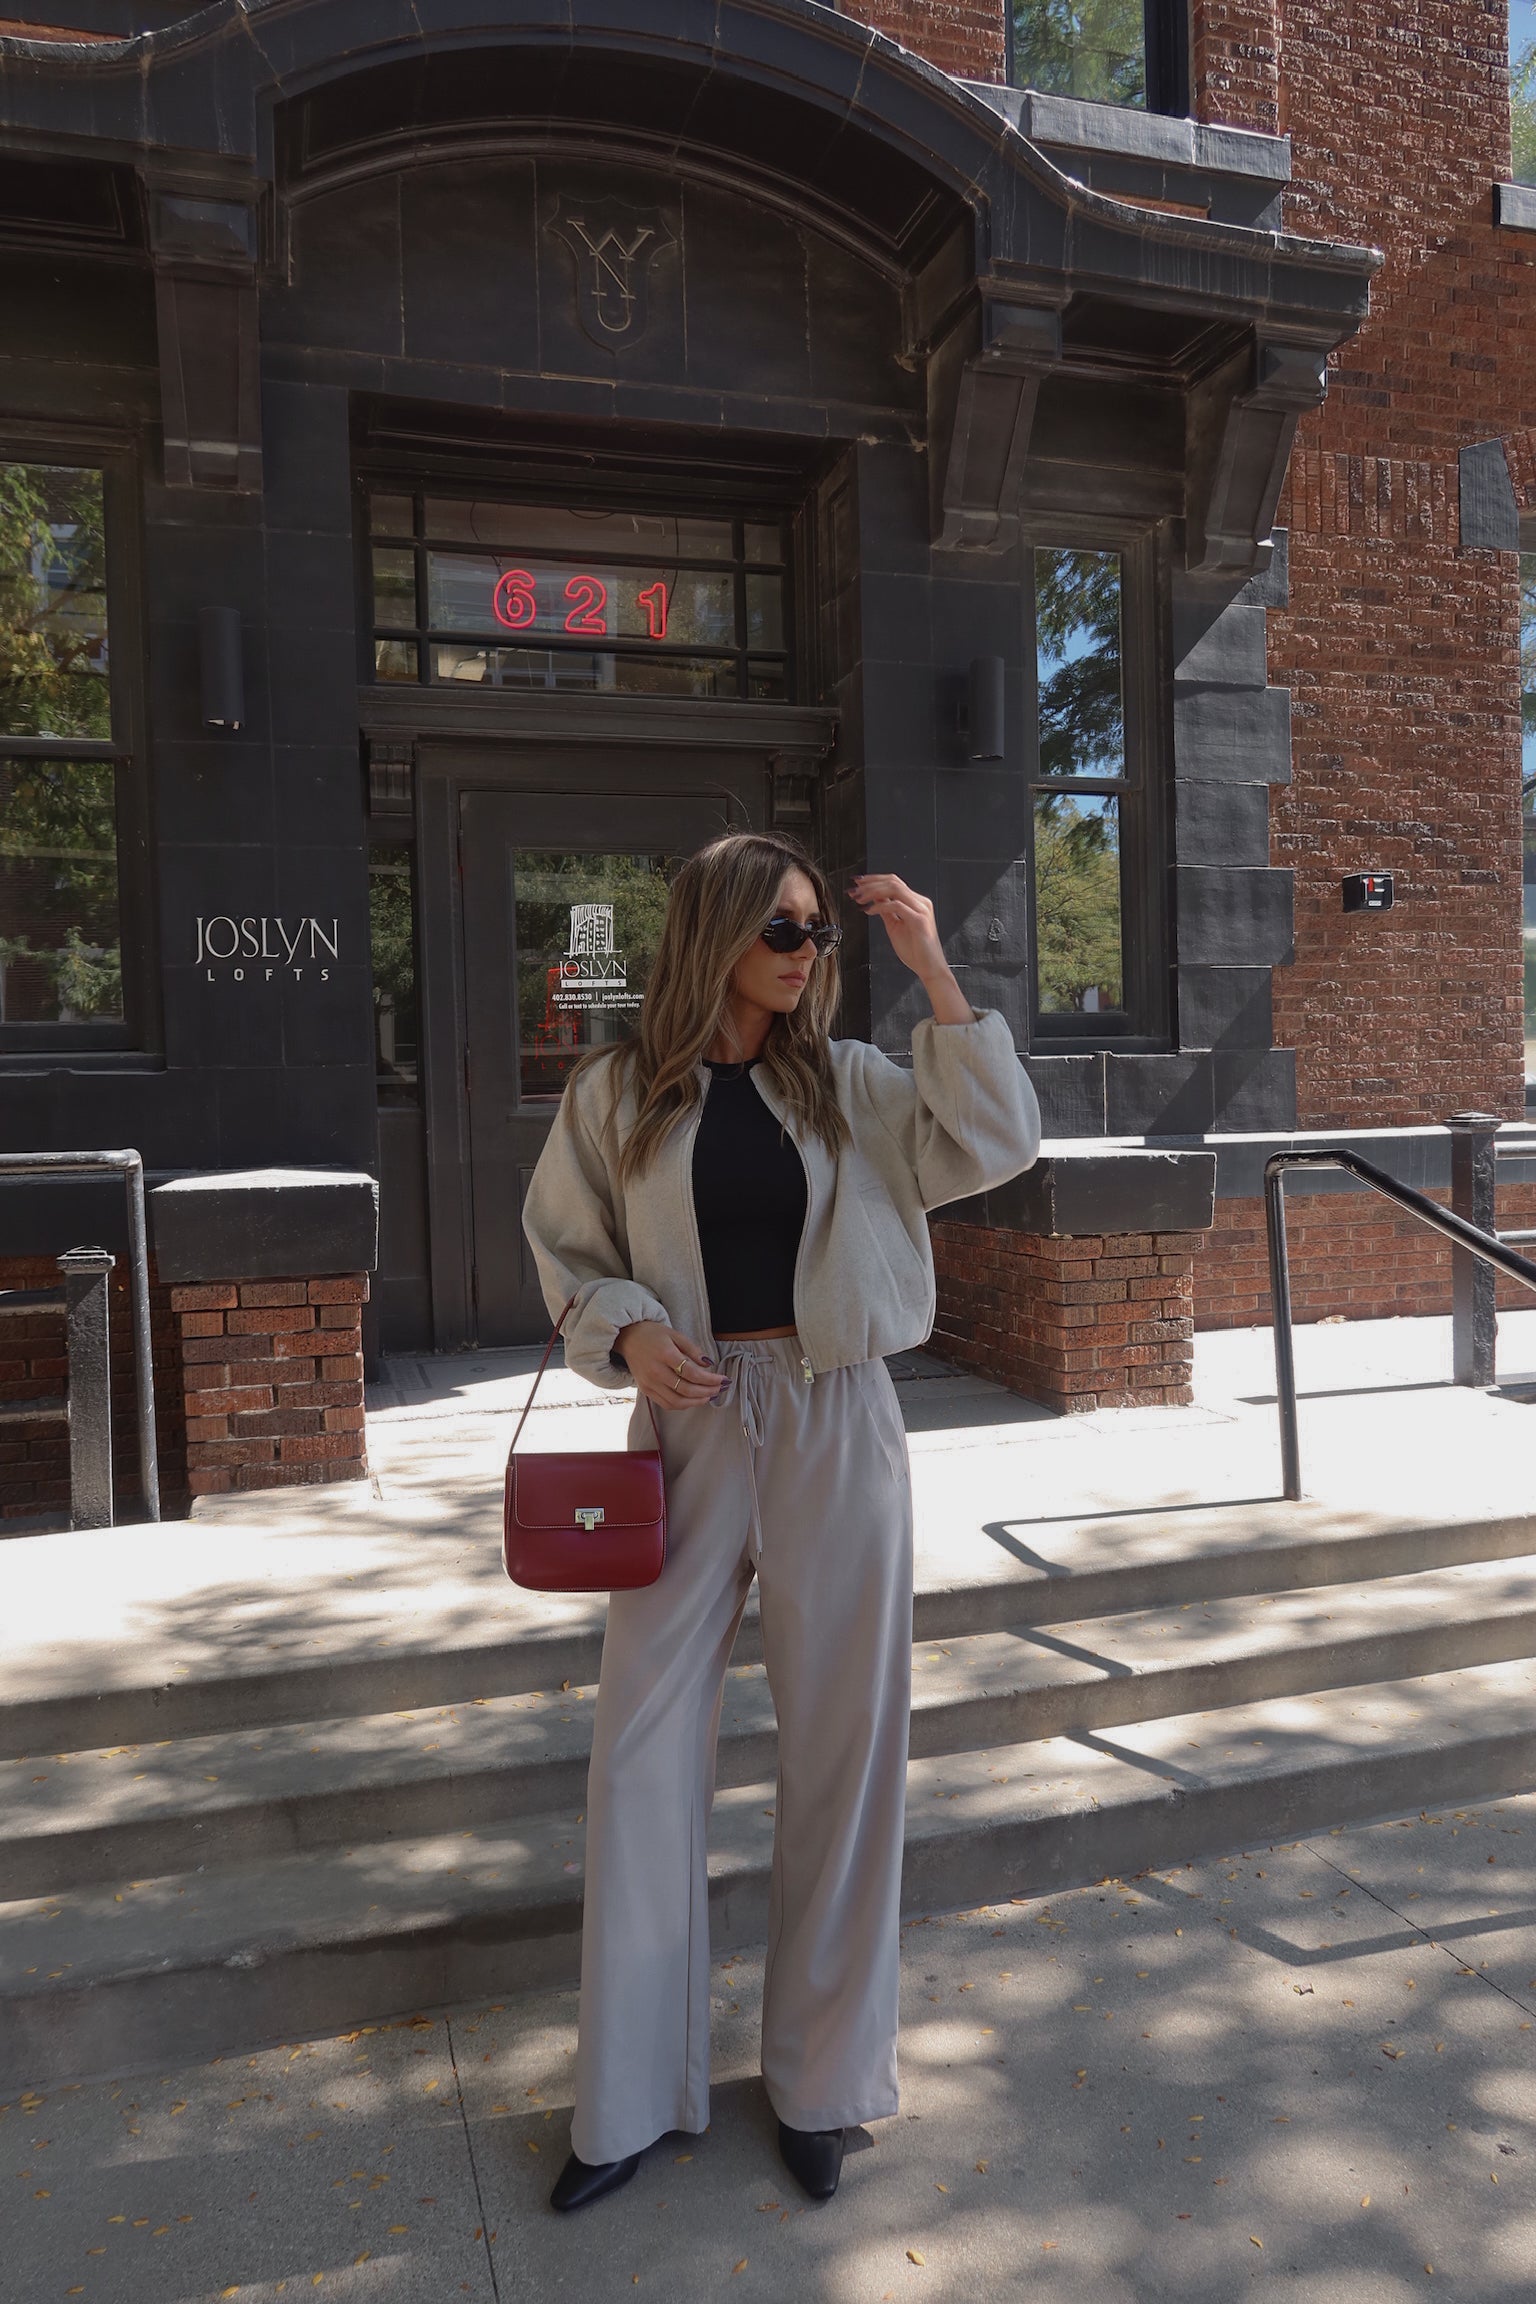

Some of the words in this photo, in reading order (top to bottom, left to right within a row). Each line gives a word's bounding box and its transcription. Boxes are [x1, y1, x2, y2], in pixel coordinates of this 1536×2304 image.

[493, 568, 668, 640] 621
[195, 916, 339, 965] JOSLYN
[207, 968, 330, 982] LOFTS
[559, 959, 627, 979] JOSLYN
[602, 992, 645, 1002] joslynlofts.com
